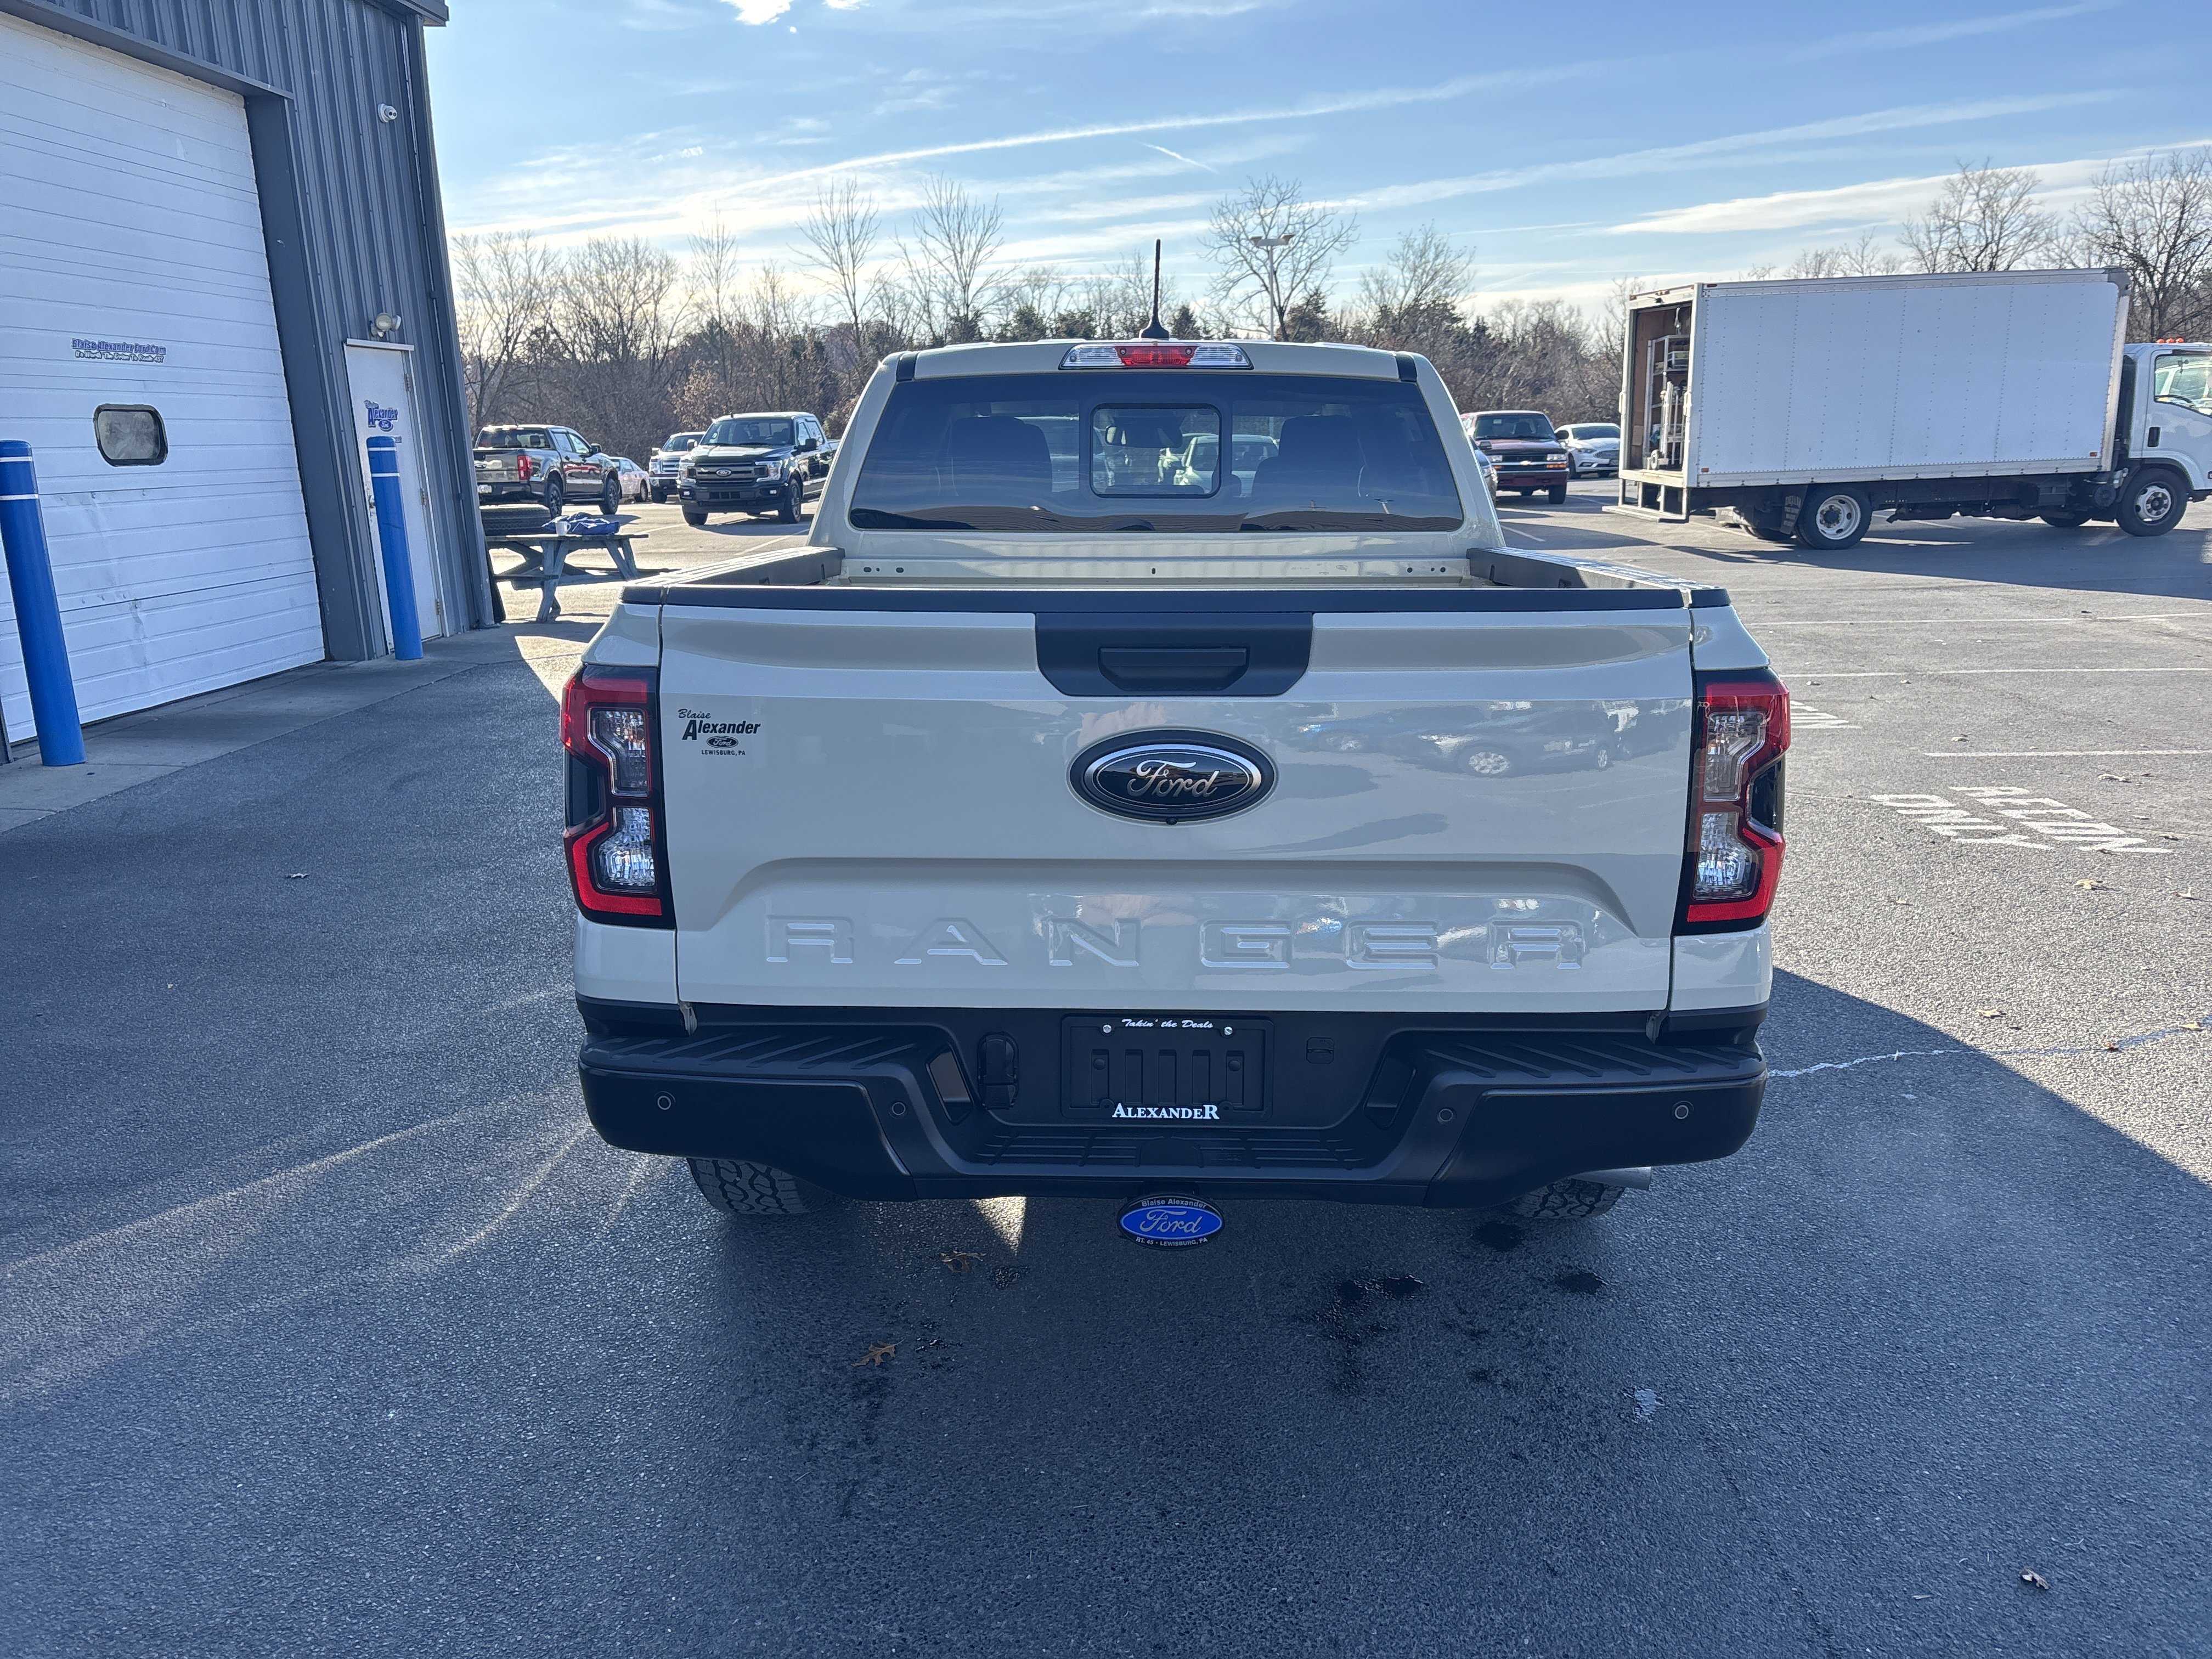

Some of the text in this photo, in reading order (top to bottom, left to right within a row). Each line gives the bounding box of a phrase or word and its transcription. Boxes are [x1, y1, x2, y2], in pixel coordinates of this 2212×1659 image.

[97, 341, 134, 353] Alexander
[368, 408, 398, 427] Alexander
[678, 708, 711, 719] Blaise
[682, 720, 761, 740] Alexander
[713, 737, 732, 747] Ford
[1126, 759, 1220, 798] Ford
[1869, 794, 2055, 850] ONLY
[765, 915, 1584, 969] RANGER
[1181, 1019, 1214, 1028] Deals
[1111, 1103, 1220, 1120] ALEXANDER
[1141, 1198, 1206, 1209] Blaise Alexander
[1139, 1209, 1203, 1233] Ford
